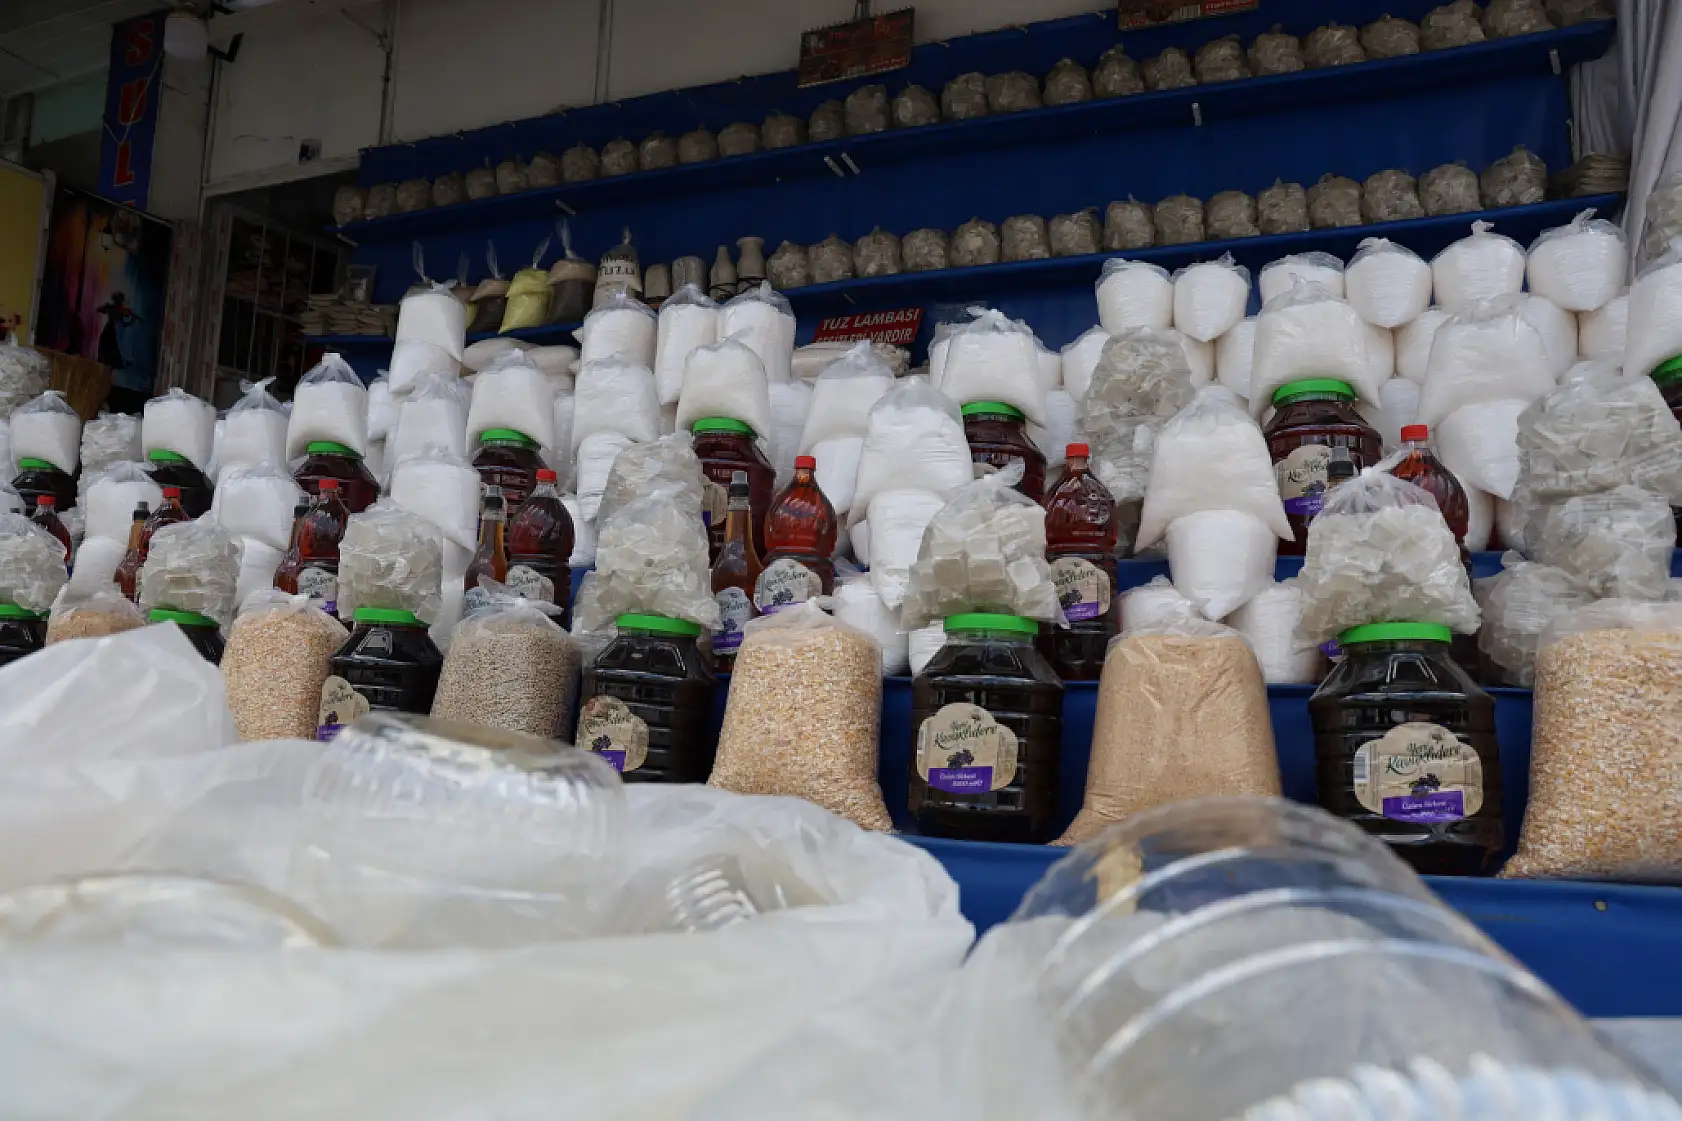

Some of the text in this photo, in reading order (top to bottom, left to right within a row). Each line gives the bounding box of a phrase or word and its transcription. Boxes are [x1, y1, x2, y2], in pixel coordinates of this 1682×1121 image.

[114, 18, 155, 210] SUL
[822, 308, 920, 331] TUZ LAMBASI
[870, 328, 913, 344] VARDIR
